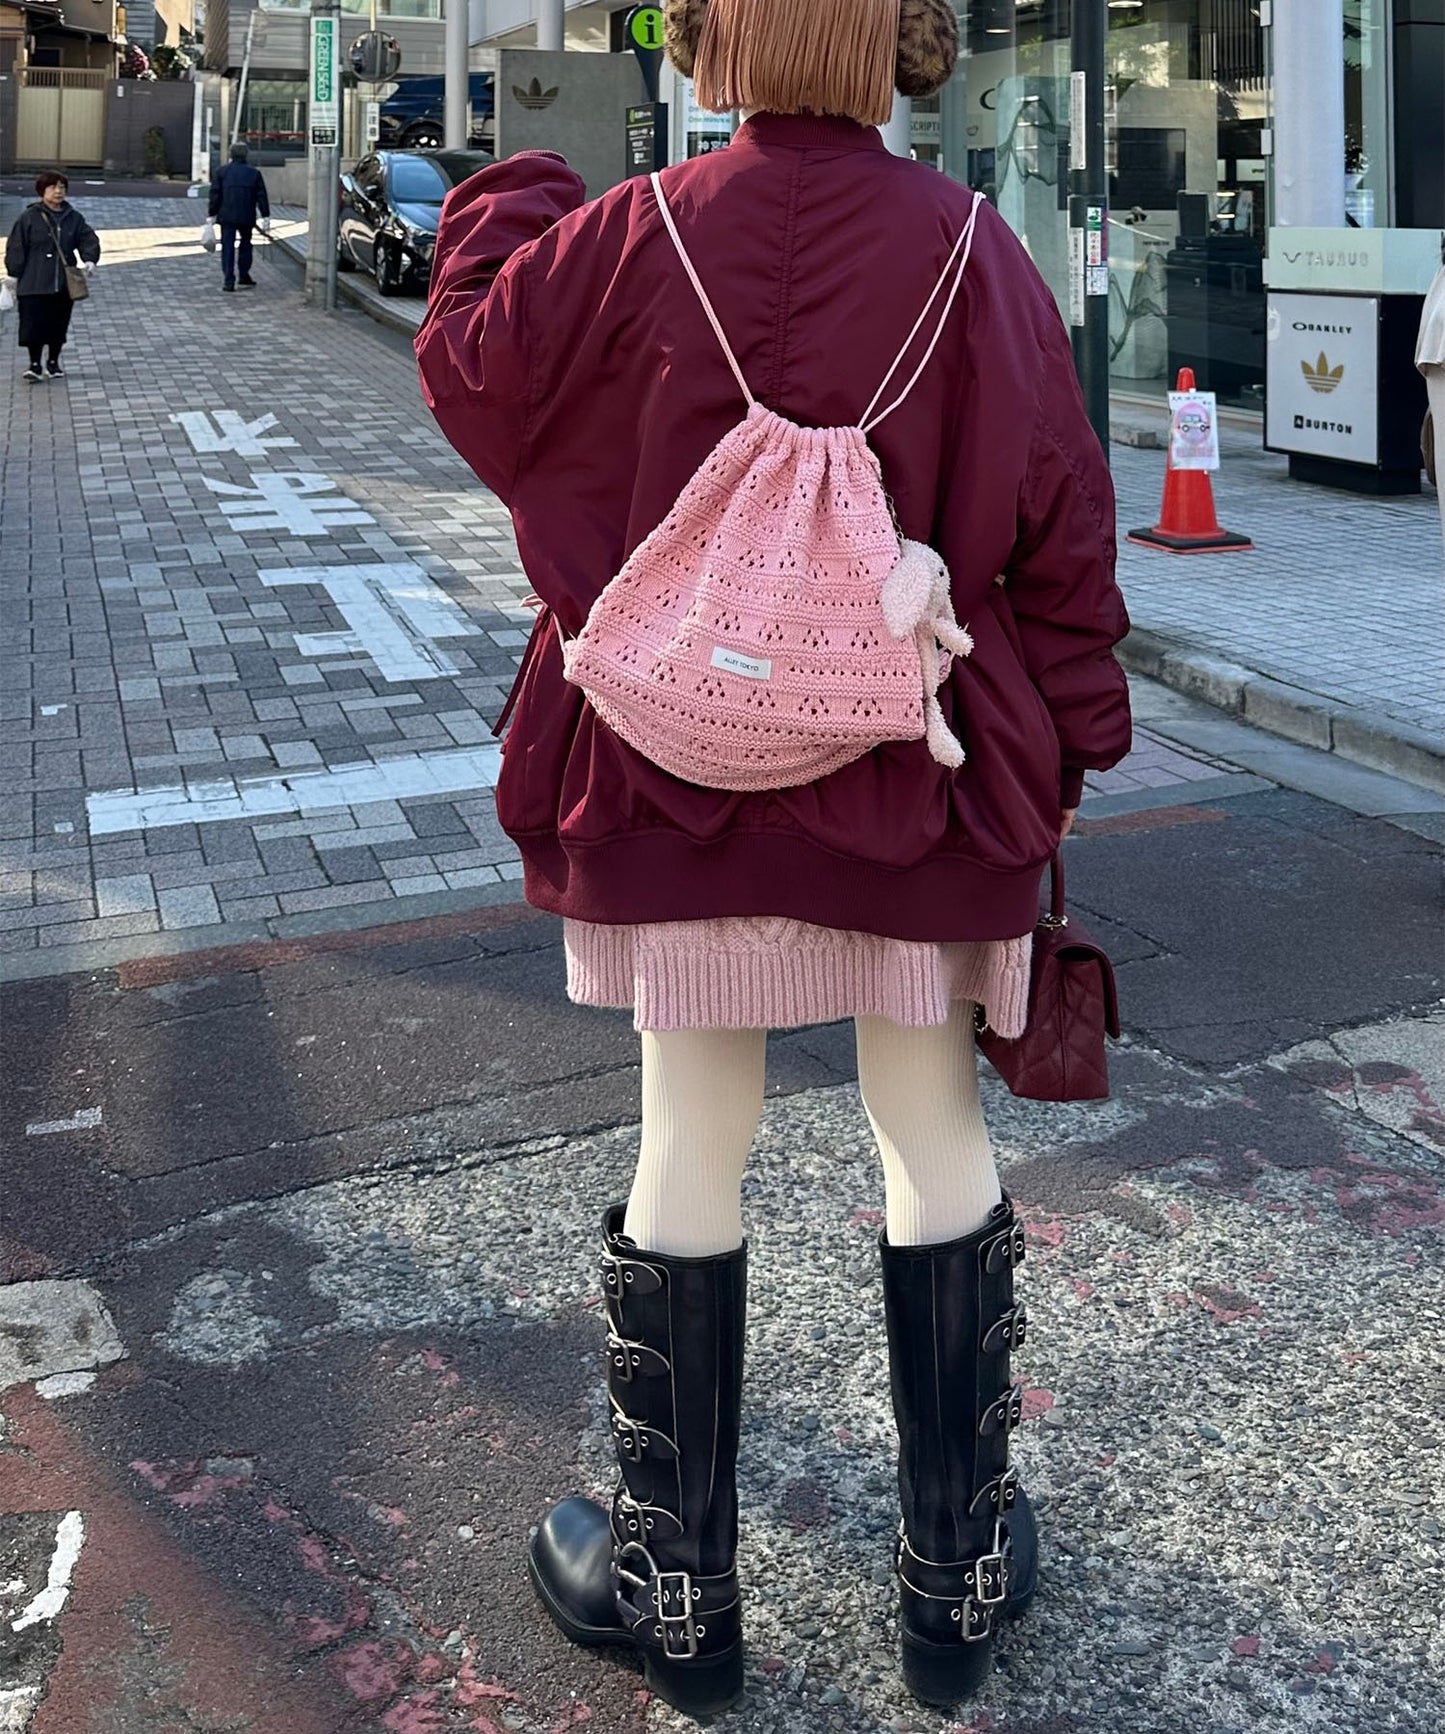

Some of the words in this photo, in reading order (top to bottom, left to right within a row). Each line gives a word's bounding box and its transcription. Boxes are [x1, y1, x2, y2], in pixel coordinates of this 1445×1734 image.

[1305, 251, 1369, 268] TAURUS
[1308, 323, 1352, 335] OAKLEY
[1306, 418, 1352, 434] BURTON
